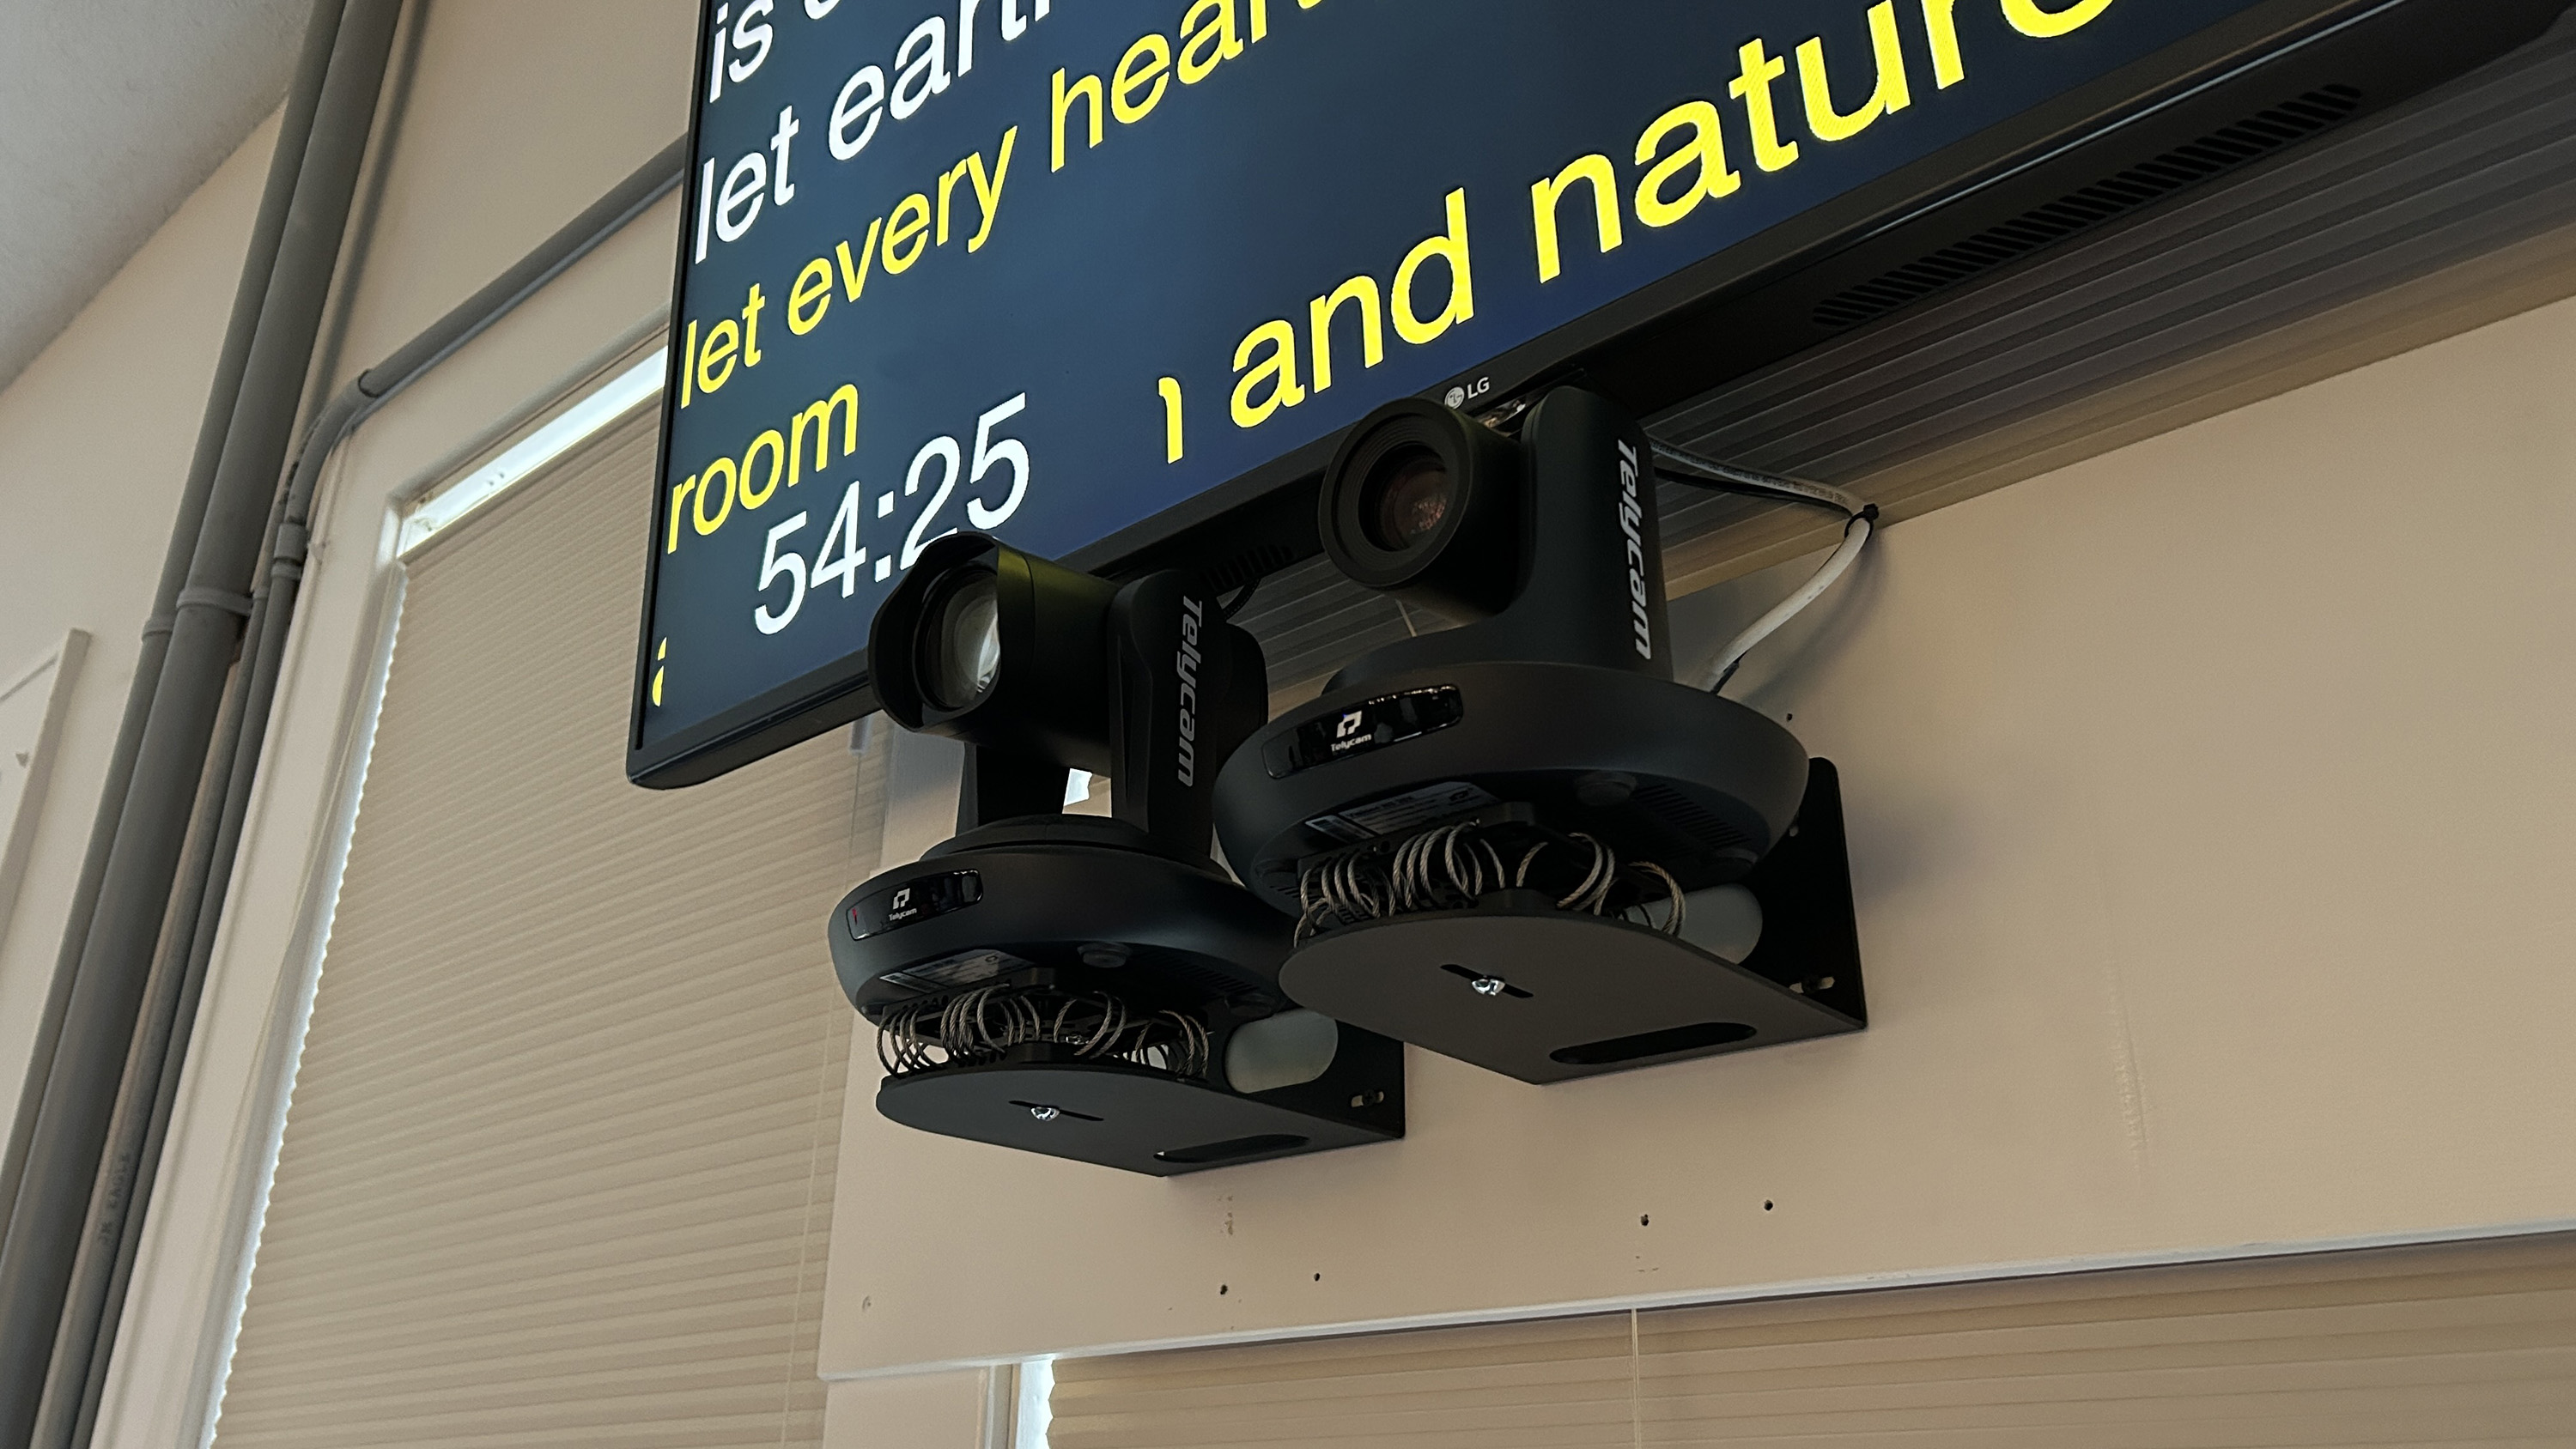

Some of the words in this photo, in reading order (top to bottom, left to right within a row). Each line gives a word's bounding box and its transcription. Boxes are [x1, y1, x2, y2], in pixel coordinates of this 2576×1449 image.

[694, 105, 800, 264] let
[829, 0, 1050, 161] ear
[709, 0, 774, 103] is
[680, 282, 766, 409] let
[787, 125, 1018, 336] every
[1230, 187, 1474, 428] and
[1531, 0, 2113, 284] natur
[667, 384, 859, 555] room
[1467, 376, 1490, 399] LG
[755, 392, 1030, 635] 54:25
[1618, 439, 1651, 659] Telycam
[1176, 596, 1202, 786] Telycam
[1330, 734, 1371, 752] Telycam
